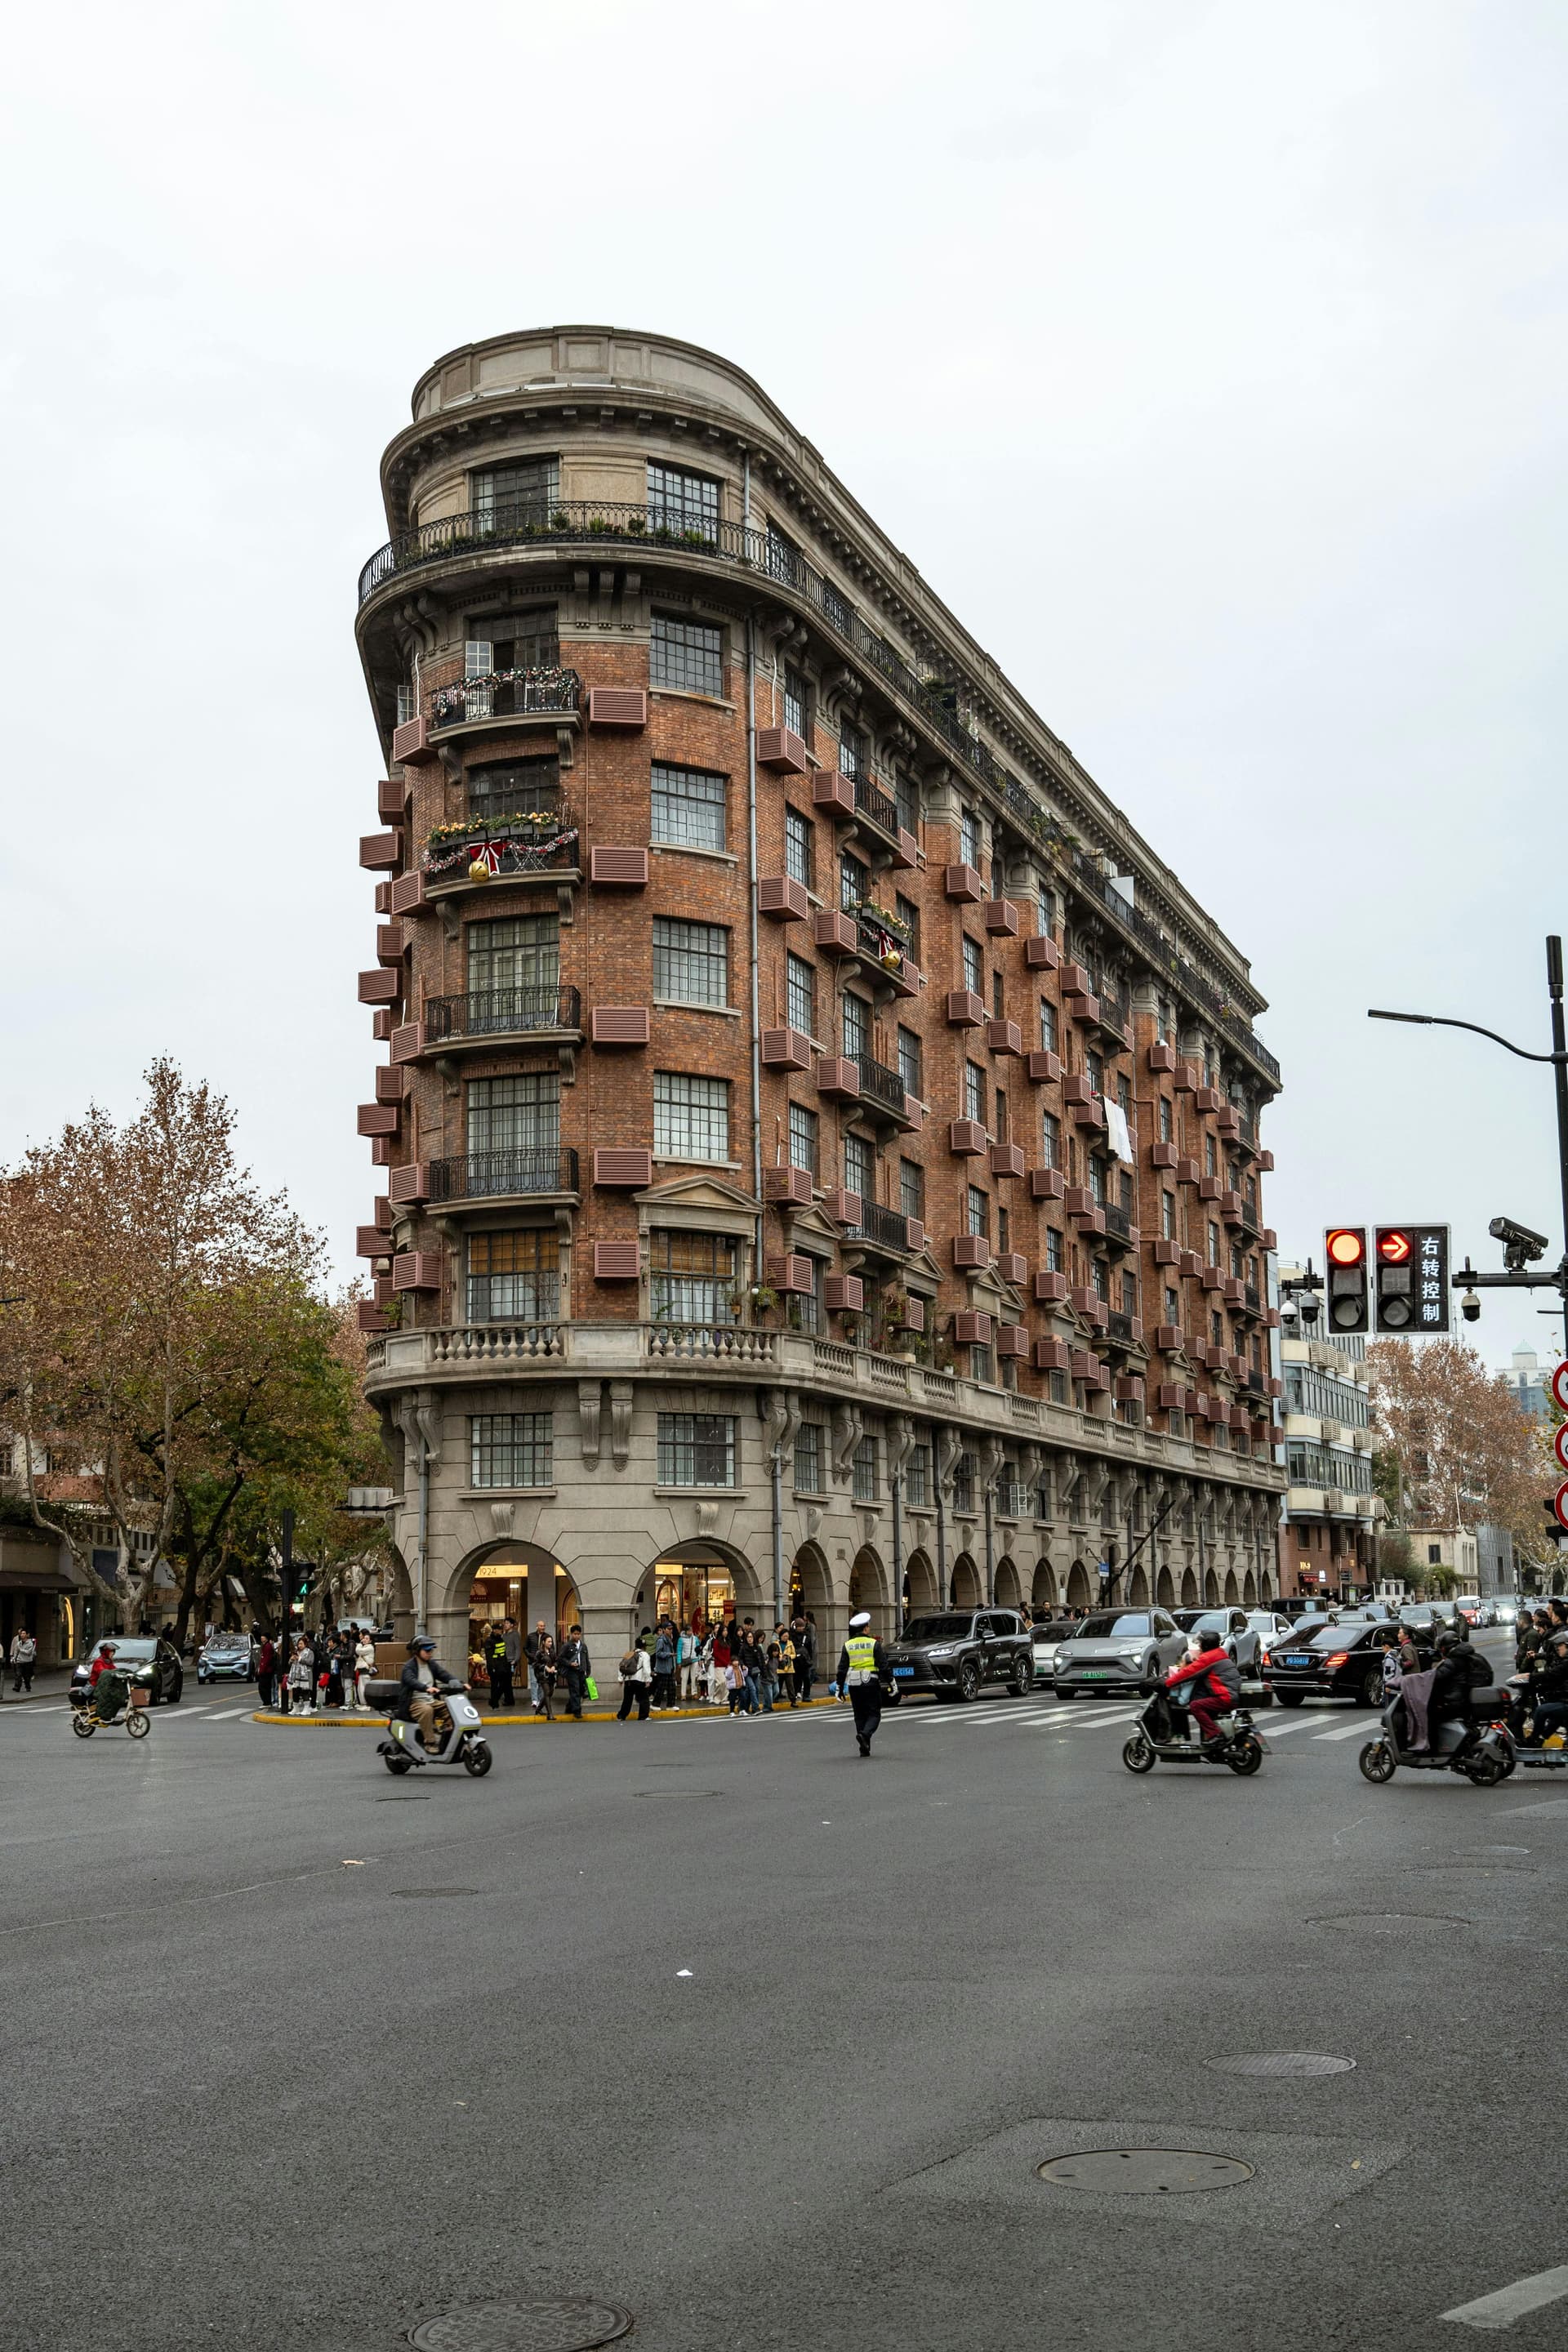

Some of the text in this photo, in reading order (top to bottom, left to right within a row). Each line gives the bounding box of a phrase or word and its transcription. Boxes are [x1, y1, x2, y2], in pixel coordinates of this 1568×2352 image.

[1421, 1236, 1440, 1322] 右转控制
[479, 1567, 497, 1576] 1924
